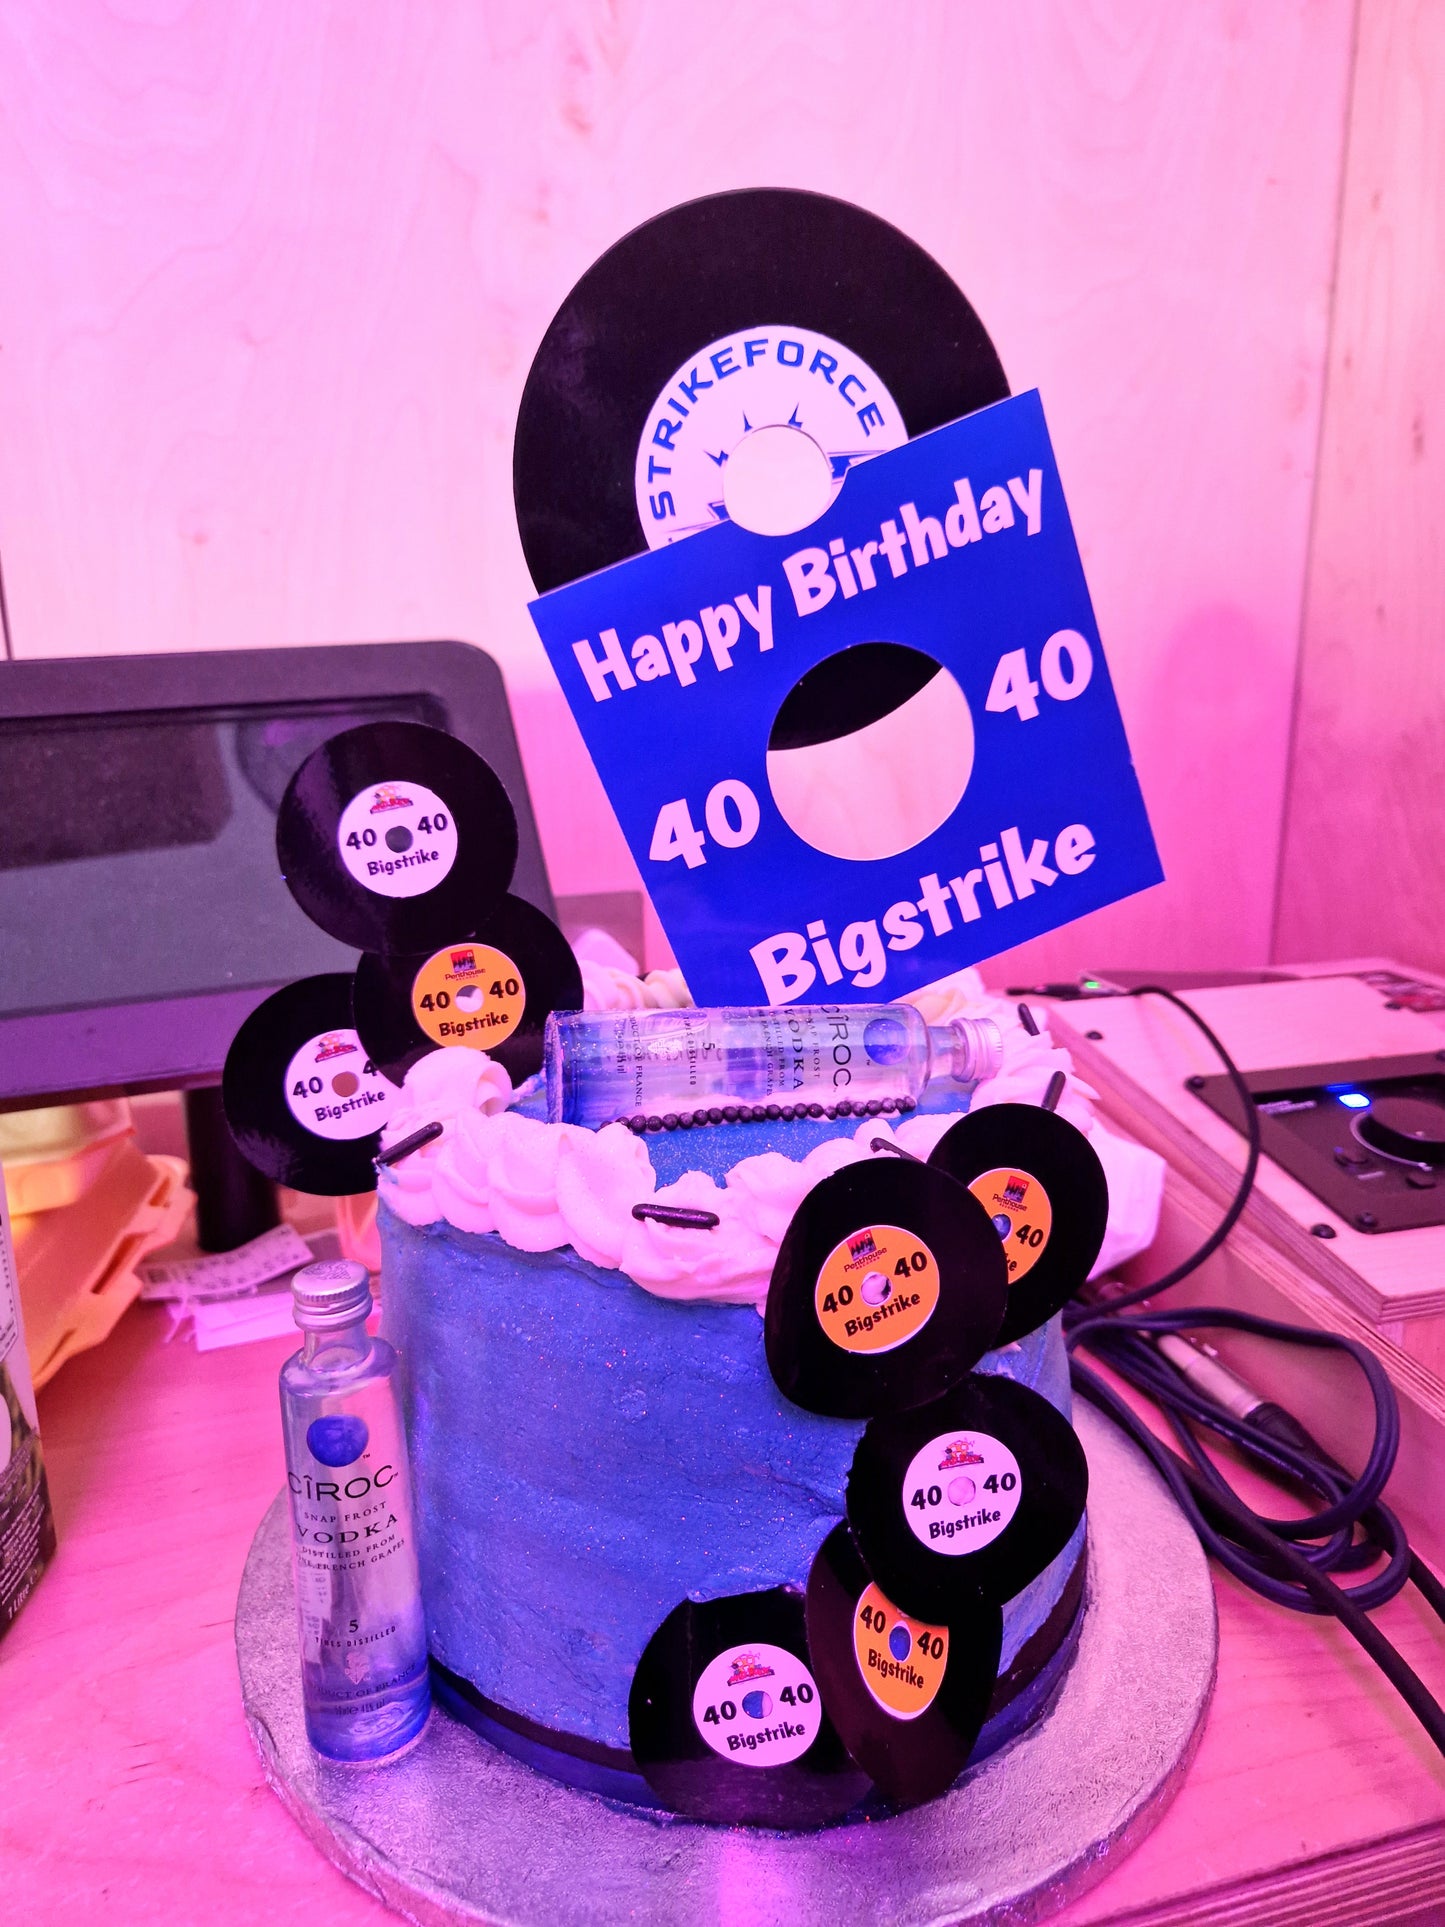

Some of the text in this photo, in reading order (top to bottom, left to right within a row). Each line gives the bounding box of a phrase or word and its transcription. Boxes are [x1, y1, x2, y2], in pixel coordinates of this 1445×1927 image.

[648, 338, 886, 521] STRIKEFORCE
[571, 468, 1044, 702] Happy Birthday
[985, 628, 1094, 722] 40
[345, 813, 448, 850] 40 40
[648, 778, 761, 869] 40
[367, 848, 439, 876] Bigstrike
[749, 823, 1097, 1006] Bigstrike
[420, 978, 520, 1012] 40 40
[439, 1011, 509, 1037] Bigstrike
[702, 1041, 716, 1052] 5
[782, 1007, 804, 1091] VODKA
[293, 1076, 323, 1099] 40
[635, 1064, 644, 1108] FRANCE
[778, 1058, 786, 1088] FROM
[315, 1089, 386, 1122] Bigstrike
[1016, 1224, 1044, 1248] 40
[844, 1247, 888, 1272] Penthouse
[822, 1285, 854, 1314] 40
[894, 1251, 927, 1278] 40
[844, 1292, 921, 1337] Bigstrike
[911, 1472, 1016, 1510] 40 40
[296, 1513, 398, 1543] VODKA
[304, 1501, 387, 1523] SNAP FROST
[928, 1507, 1001, 1539] Bigstrike
[302, 1534, 396, 1559] DISTILLED FROM
[347, 1625, 396, 1647] DISTILLED
[349, 1619, 359, 1633] 5
[860, 1605, 944, 1659] 40 40
[868, 1648, 924, 1689] Bigstrike
[703, 1682, 813, 1725] 40 40
[727, 1721, 805, 1751] Bigstrike
